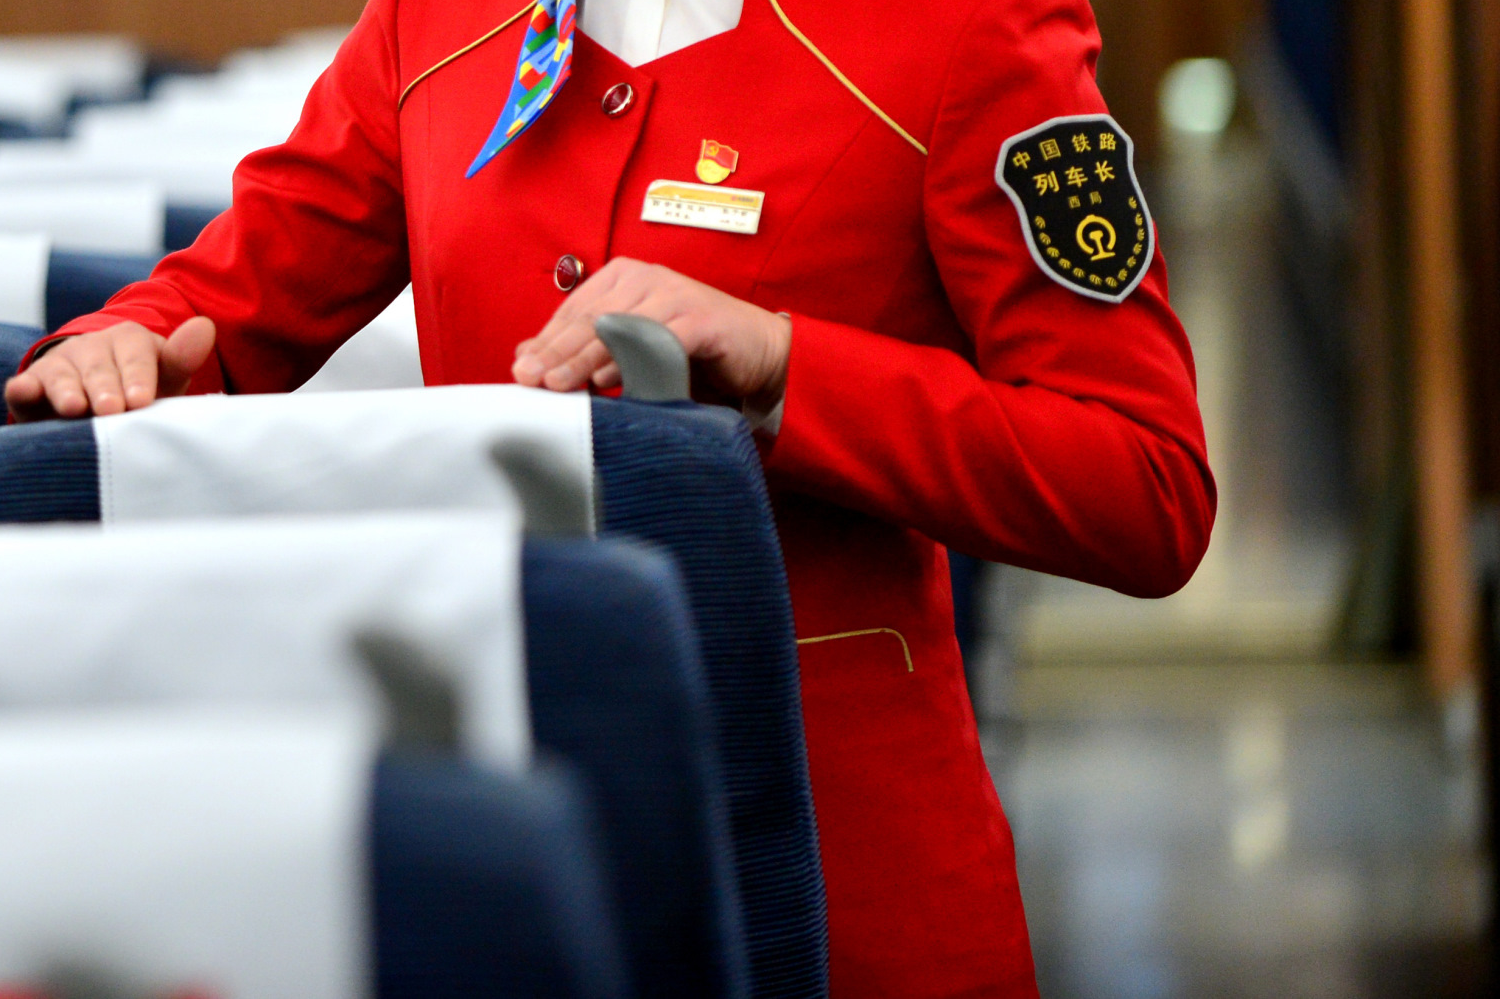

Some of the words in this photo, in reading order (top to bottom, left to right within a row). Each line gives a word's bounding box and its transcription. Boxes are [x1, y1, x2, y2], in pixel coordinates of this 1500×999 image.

[1012, 133, 1117, 170] 中国铁路
[1032, 160, 1116, 196] 列车长
